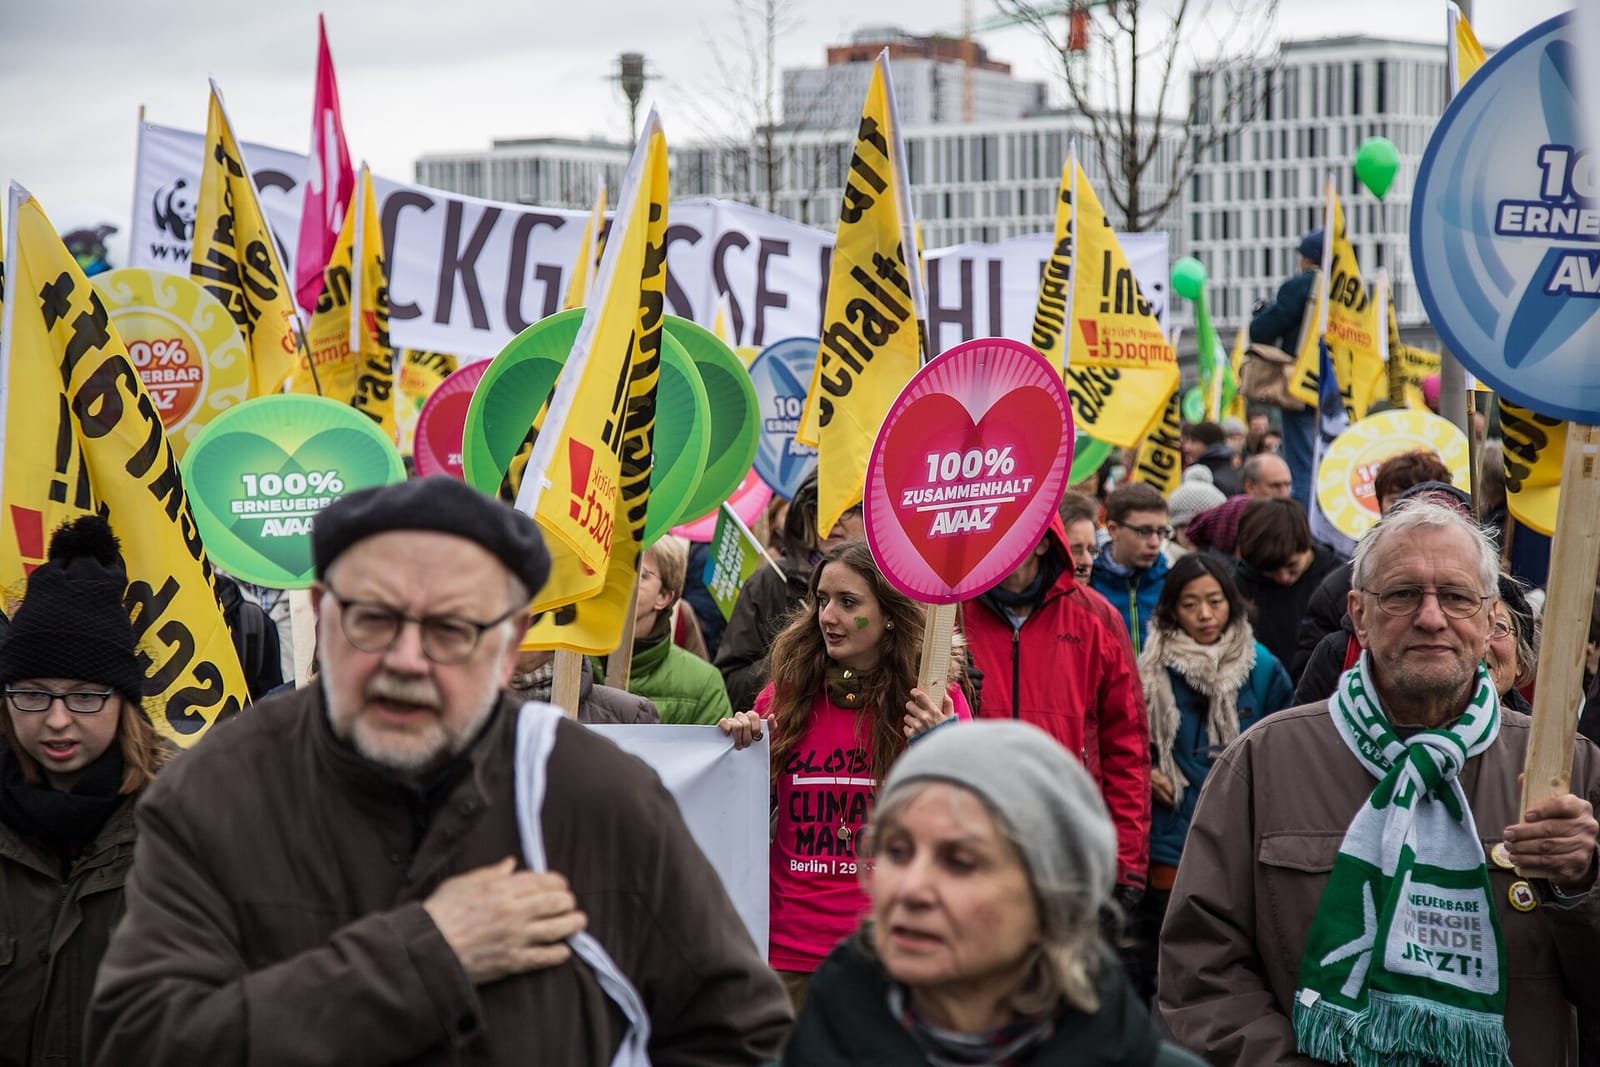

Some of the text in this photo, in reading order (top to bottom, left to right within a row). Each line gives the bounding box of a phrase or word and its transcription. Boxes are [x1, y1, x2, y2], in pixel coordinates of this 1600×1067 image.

[926, 447, 1015, 483] 100%
[241, 471, 344, 497] 100%
[902, 478, 1033, 506] ZUSAMMENHALT
[231, 497, 341, 514] ERNEUERB
[260, 517, 316, 538] AVAA
[929, 506, 999, 536] AVAAZ
[790, 859, 828, 874] Berlin
[1401, 941, 1483, 978] JETZT!
